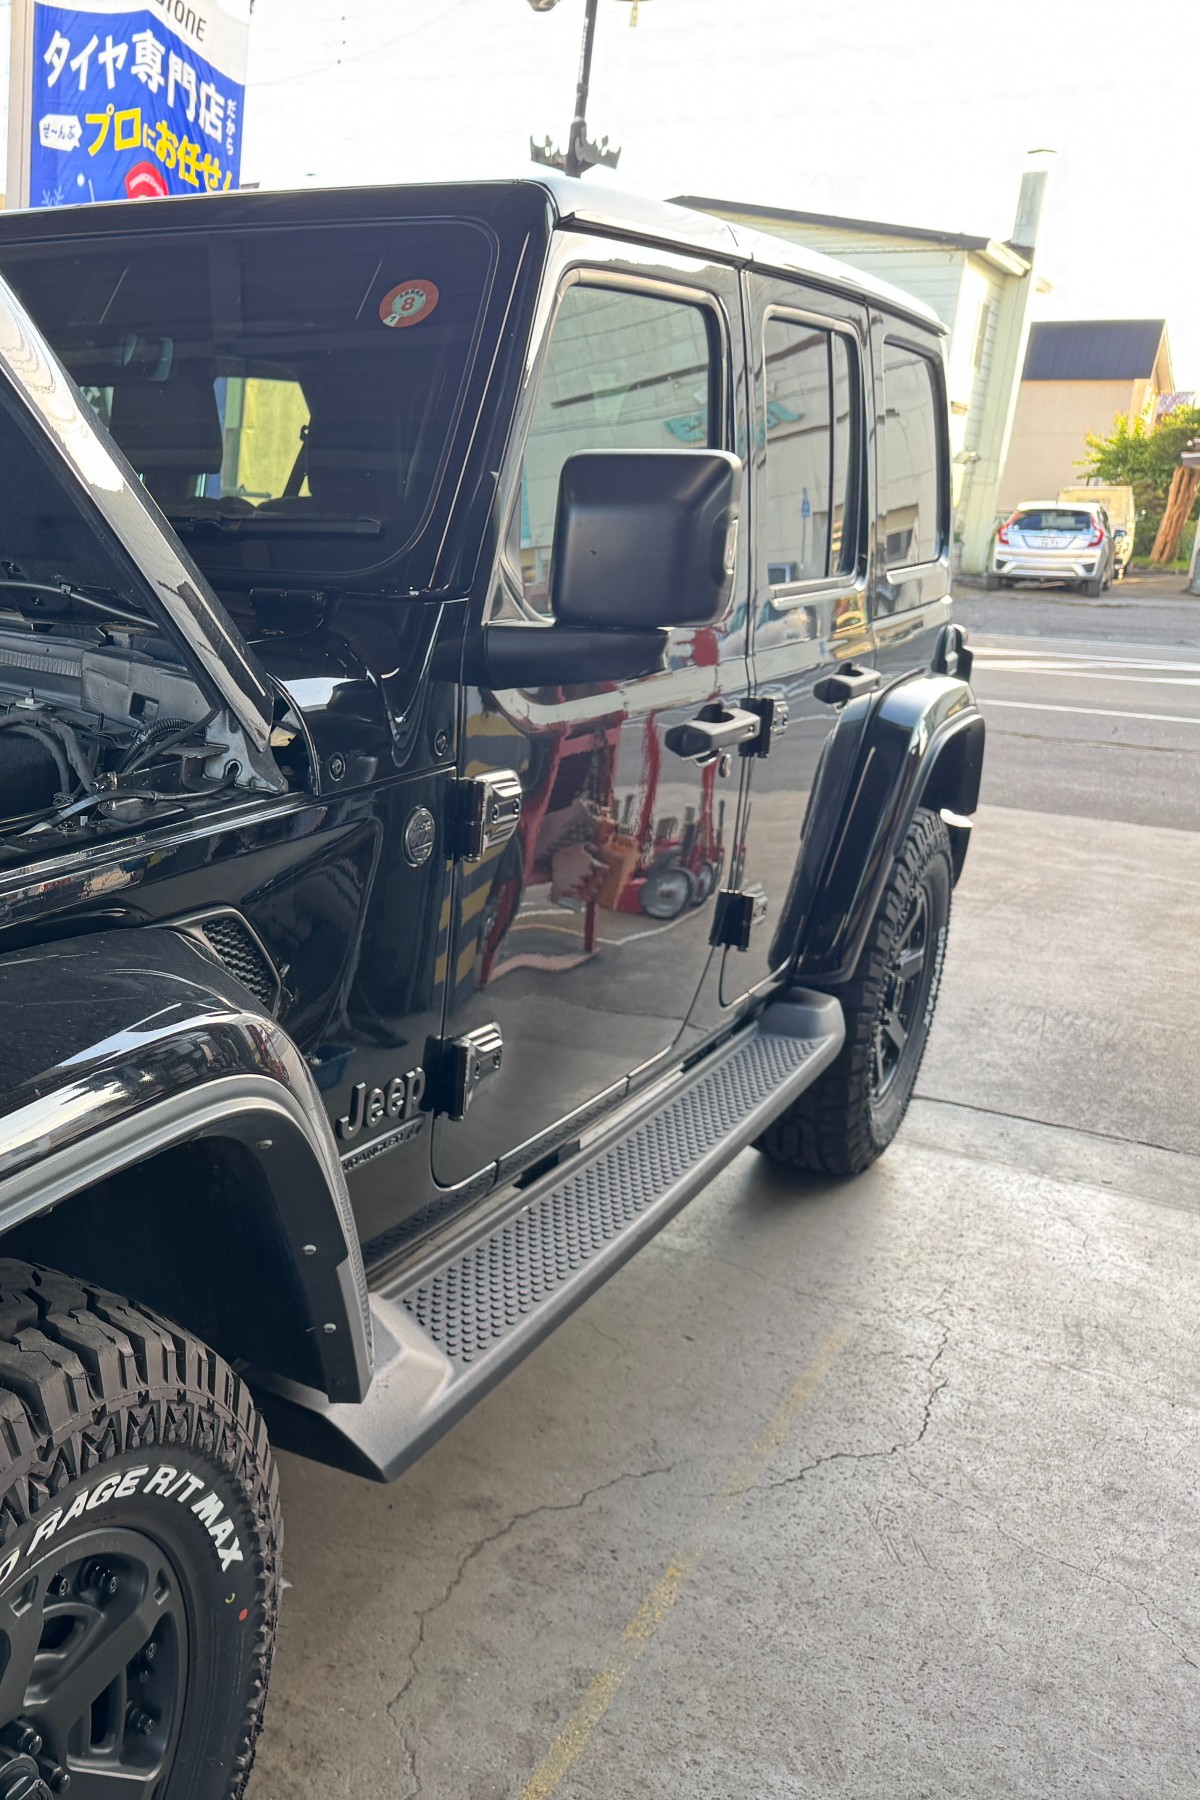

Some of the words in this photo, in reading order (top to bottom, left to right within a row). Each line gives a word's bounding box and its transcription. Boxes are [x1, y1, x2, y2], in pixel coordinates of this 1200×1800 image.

[43, 28, 225, 144] タイヤ専門店
[226, 98, 237, 156] だから
[401, 296, 416, 311] 8
[335, 1066, 426, 1140] Jeep
[26, 1465, 150, 1557] RAGE
[142, 1464, 206, 1503] R/T
[190, 1493, 245, 1573] MAX
